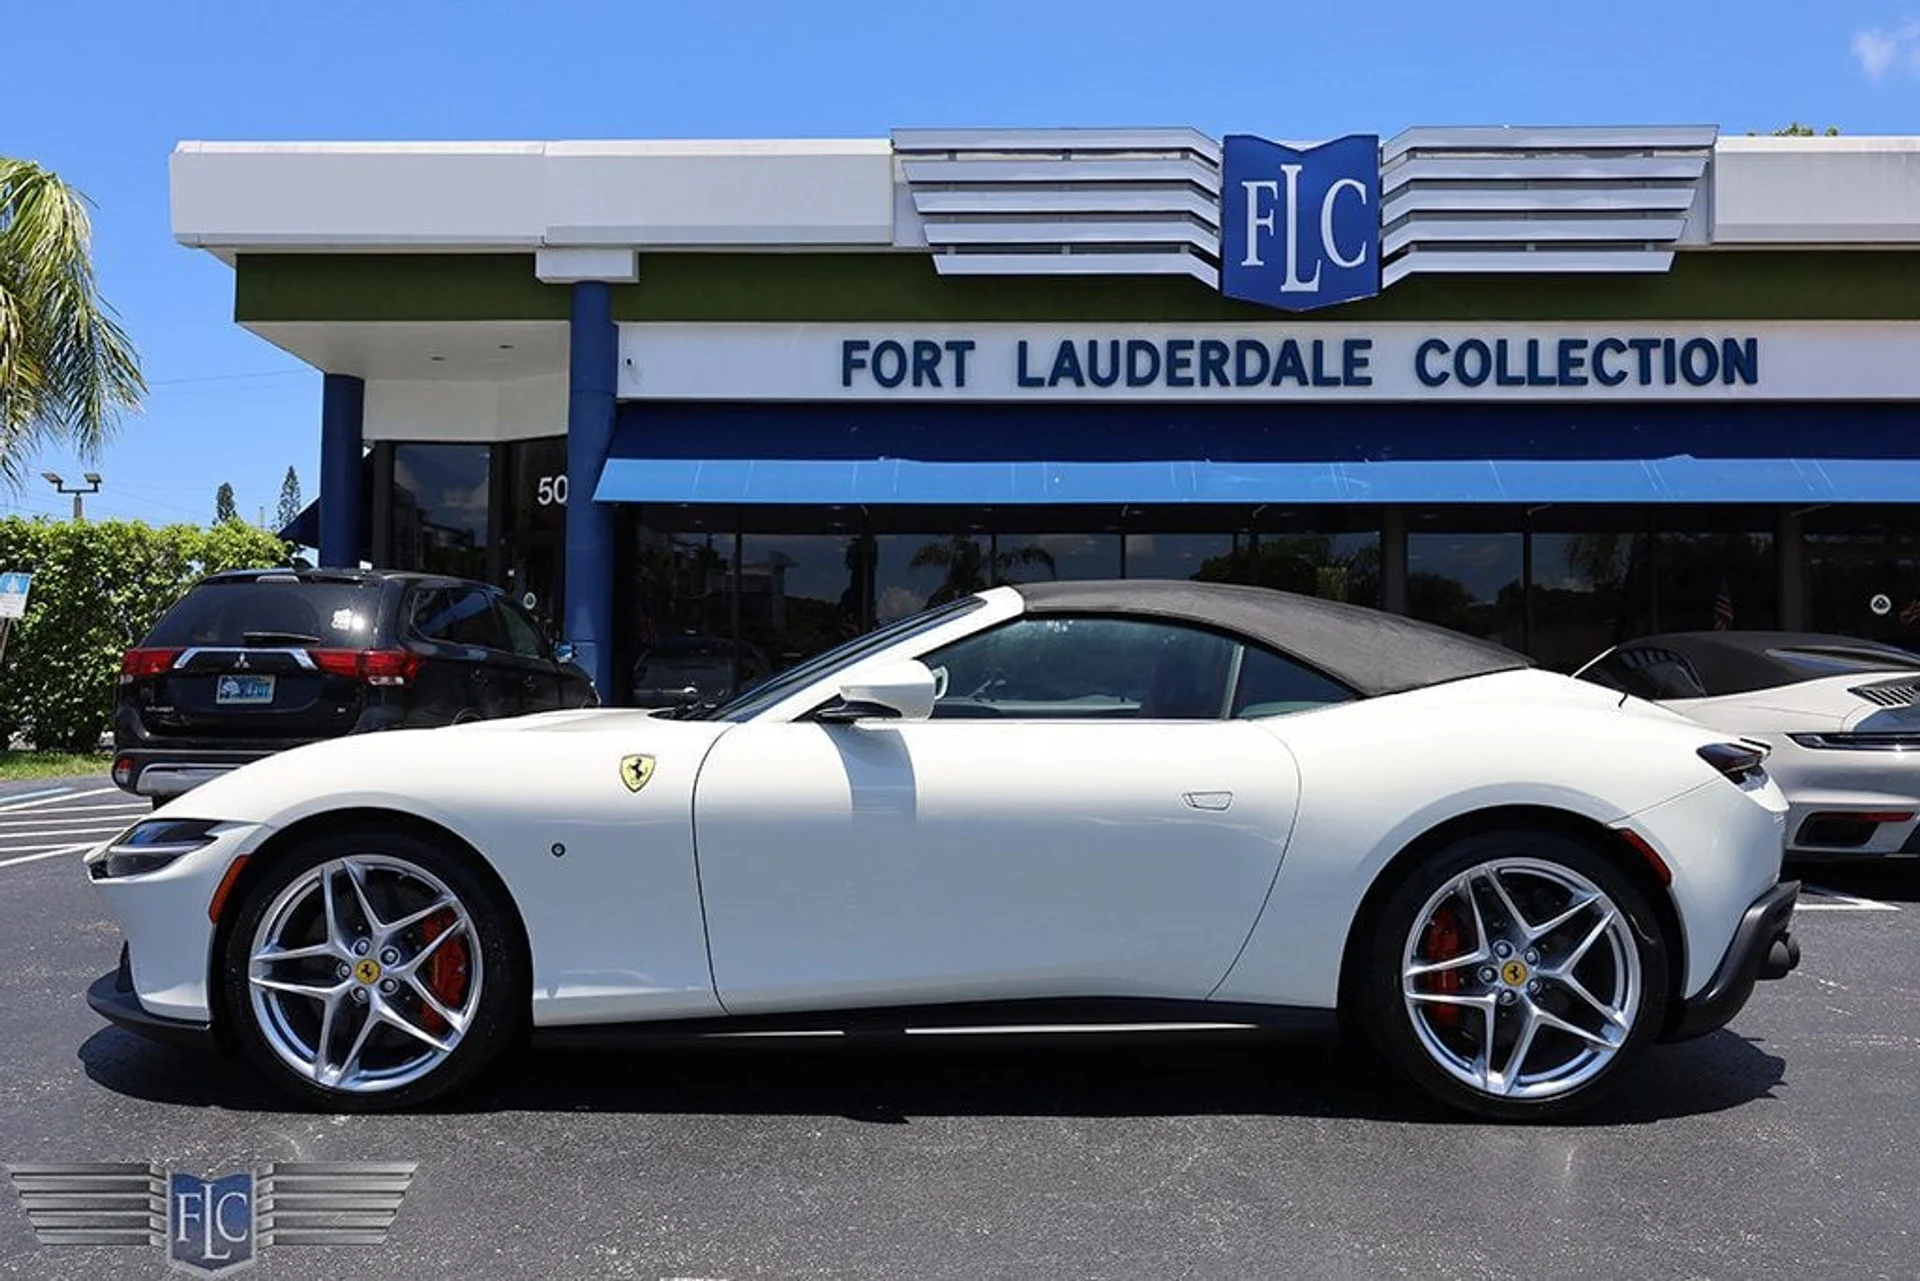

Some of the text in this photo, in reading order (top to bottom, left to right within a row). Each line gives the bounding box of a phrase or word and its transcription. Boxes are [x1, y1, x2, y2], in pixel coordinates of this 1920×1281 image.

[1241, 164, 1367, 292] FLC
[841, 337, 1759, 388] FORT LAUDERDALE COLLECTION
